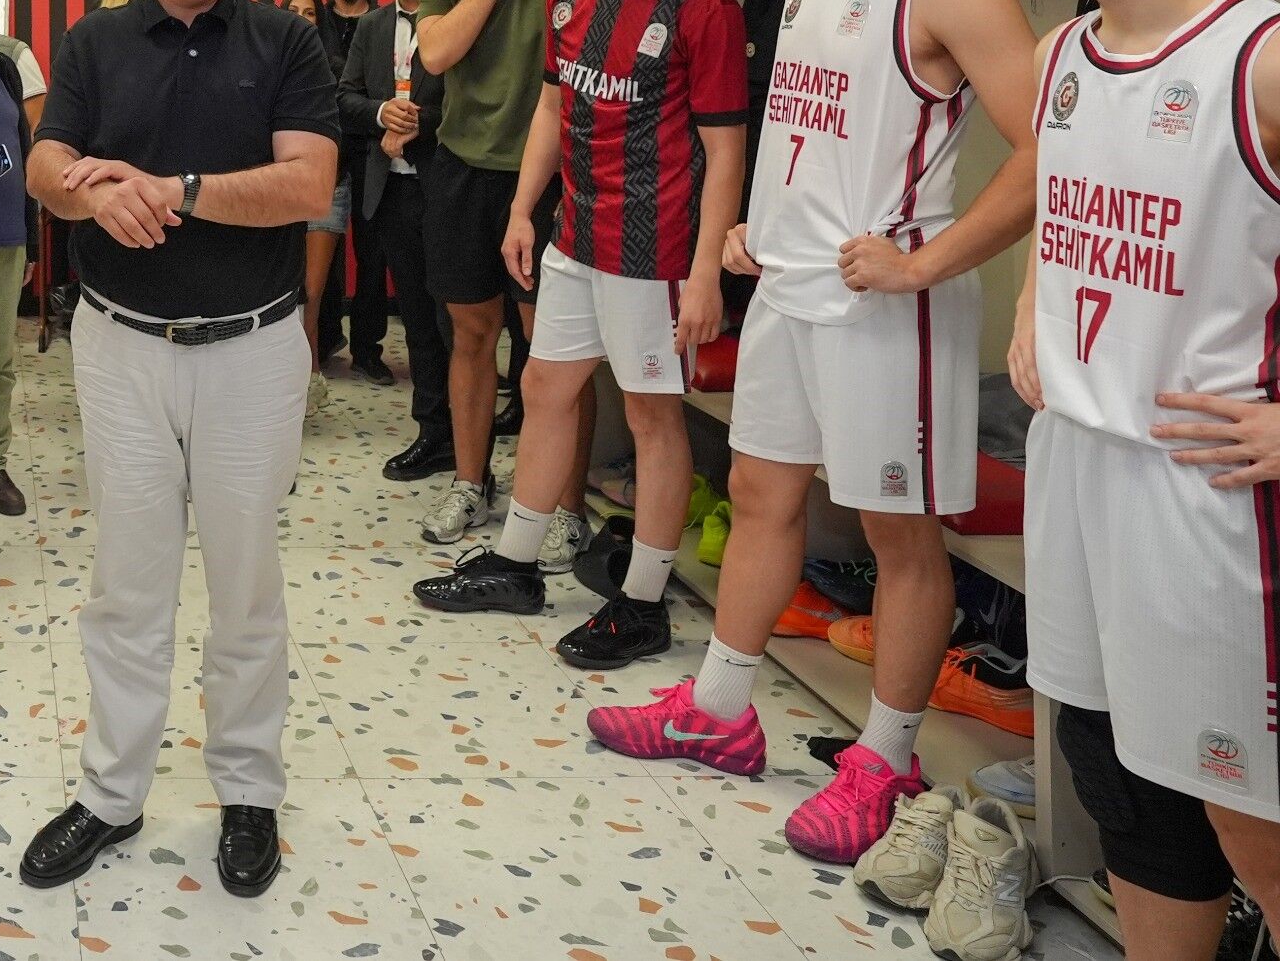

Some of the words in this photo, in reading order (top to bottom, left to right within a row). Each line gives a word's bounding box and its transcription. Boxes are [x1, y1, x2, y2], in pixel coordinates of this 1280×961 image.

[773, 60, 849, 102] GAZİANTEP
[785, 134, 805, 186] 7
[1048, 175, 1182, 240] GAZİANTEP
[1040, 221, 1184, 297] ŞEHİTKAMİL
[1075, 286, 1112, 365] 17
